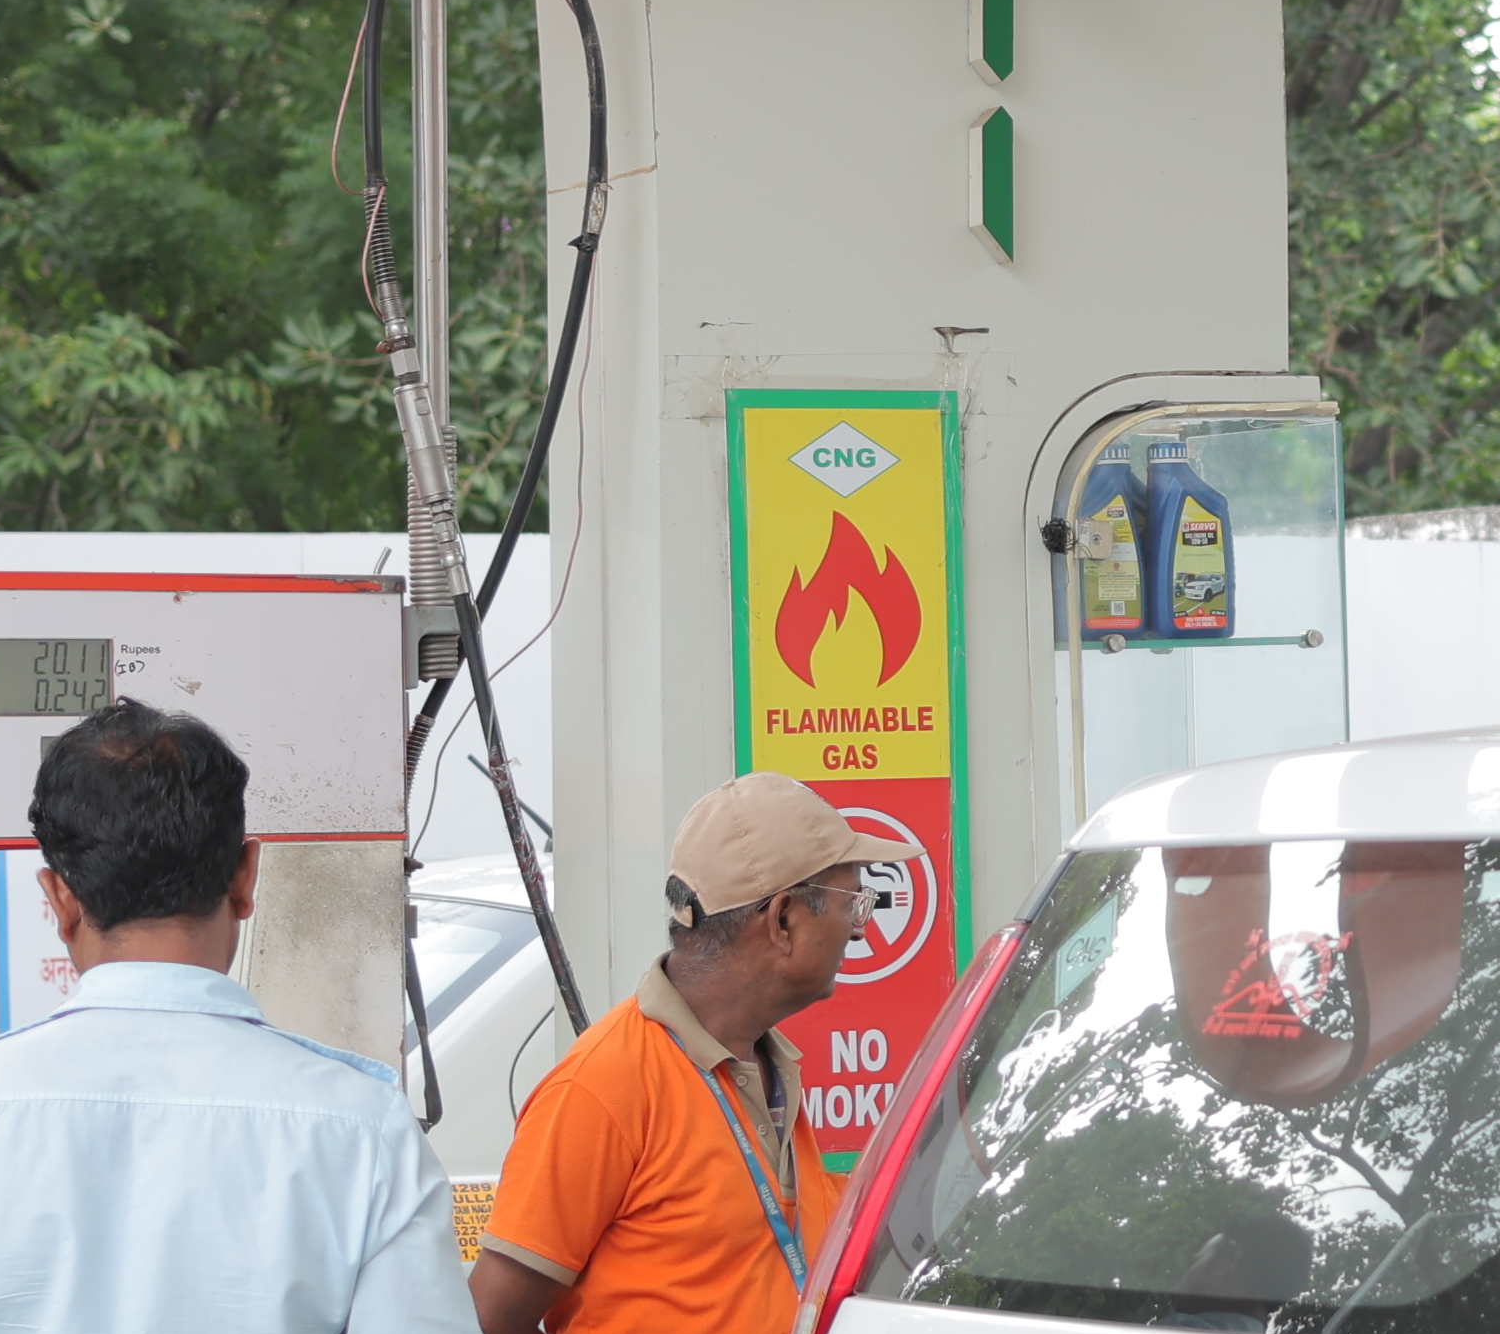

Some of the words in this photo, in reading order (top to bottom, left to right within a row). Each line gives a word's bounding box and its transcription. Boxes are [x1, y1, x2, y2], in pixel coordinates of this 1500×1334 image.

[813, 447, 877, 468] CNG
[34, 641, 106, 675] 20.11
[121, 644, 161, 656] Rupees
[767, 706, 934, 735] FLAMMABLE
[822, 744, 879, 770] GAS
[831, 1029, 888, 1073] NO
